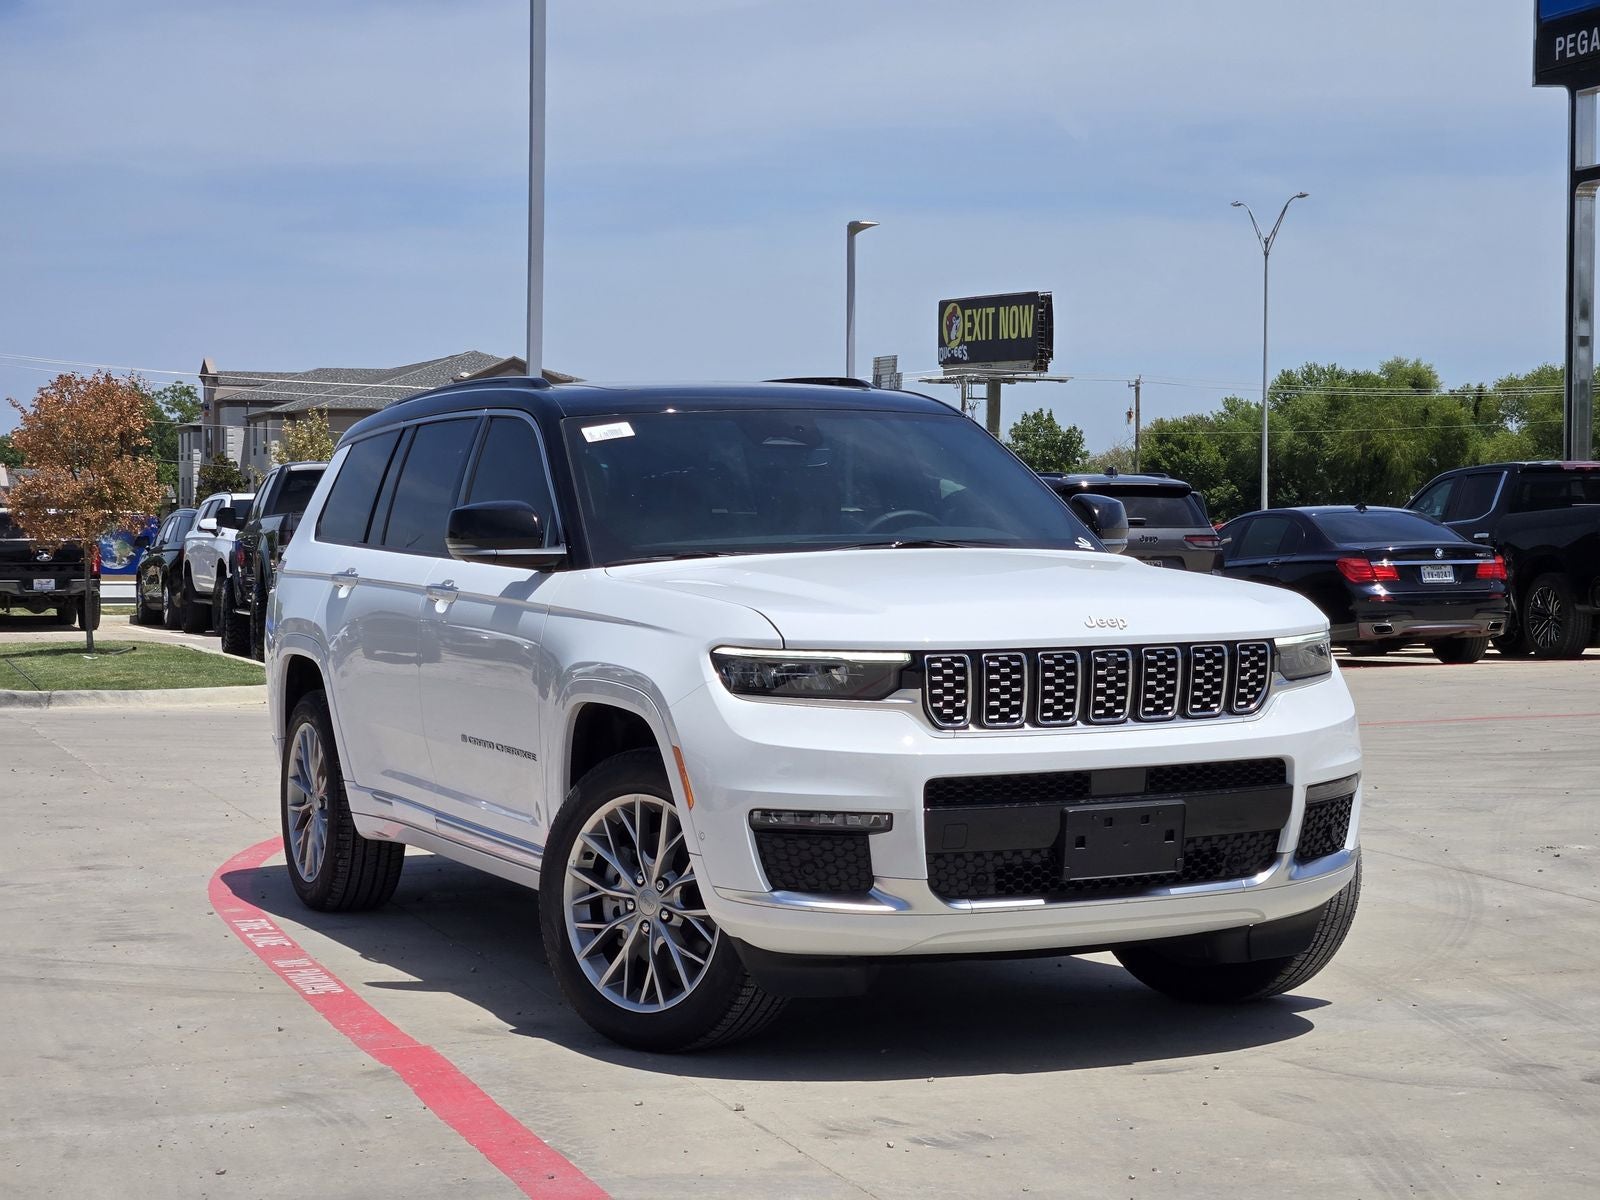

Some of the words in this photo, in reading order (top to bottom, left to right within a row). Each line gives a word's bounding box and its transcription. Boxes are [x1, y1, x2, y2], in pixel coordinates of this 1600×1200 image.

[1555, 27, 1600, 61] PEGA
[964, 307, 995, 342] EXIT
[1000, 304, 1034, 340] NOW
[1083, 615, 1127, 630] Jeep
[495, 743, 537, 762] CHEROKEE
